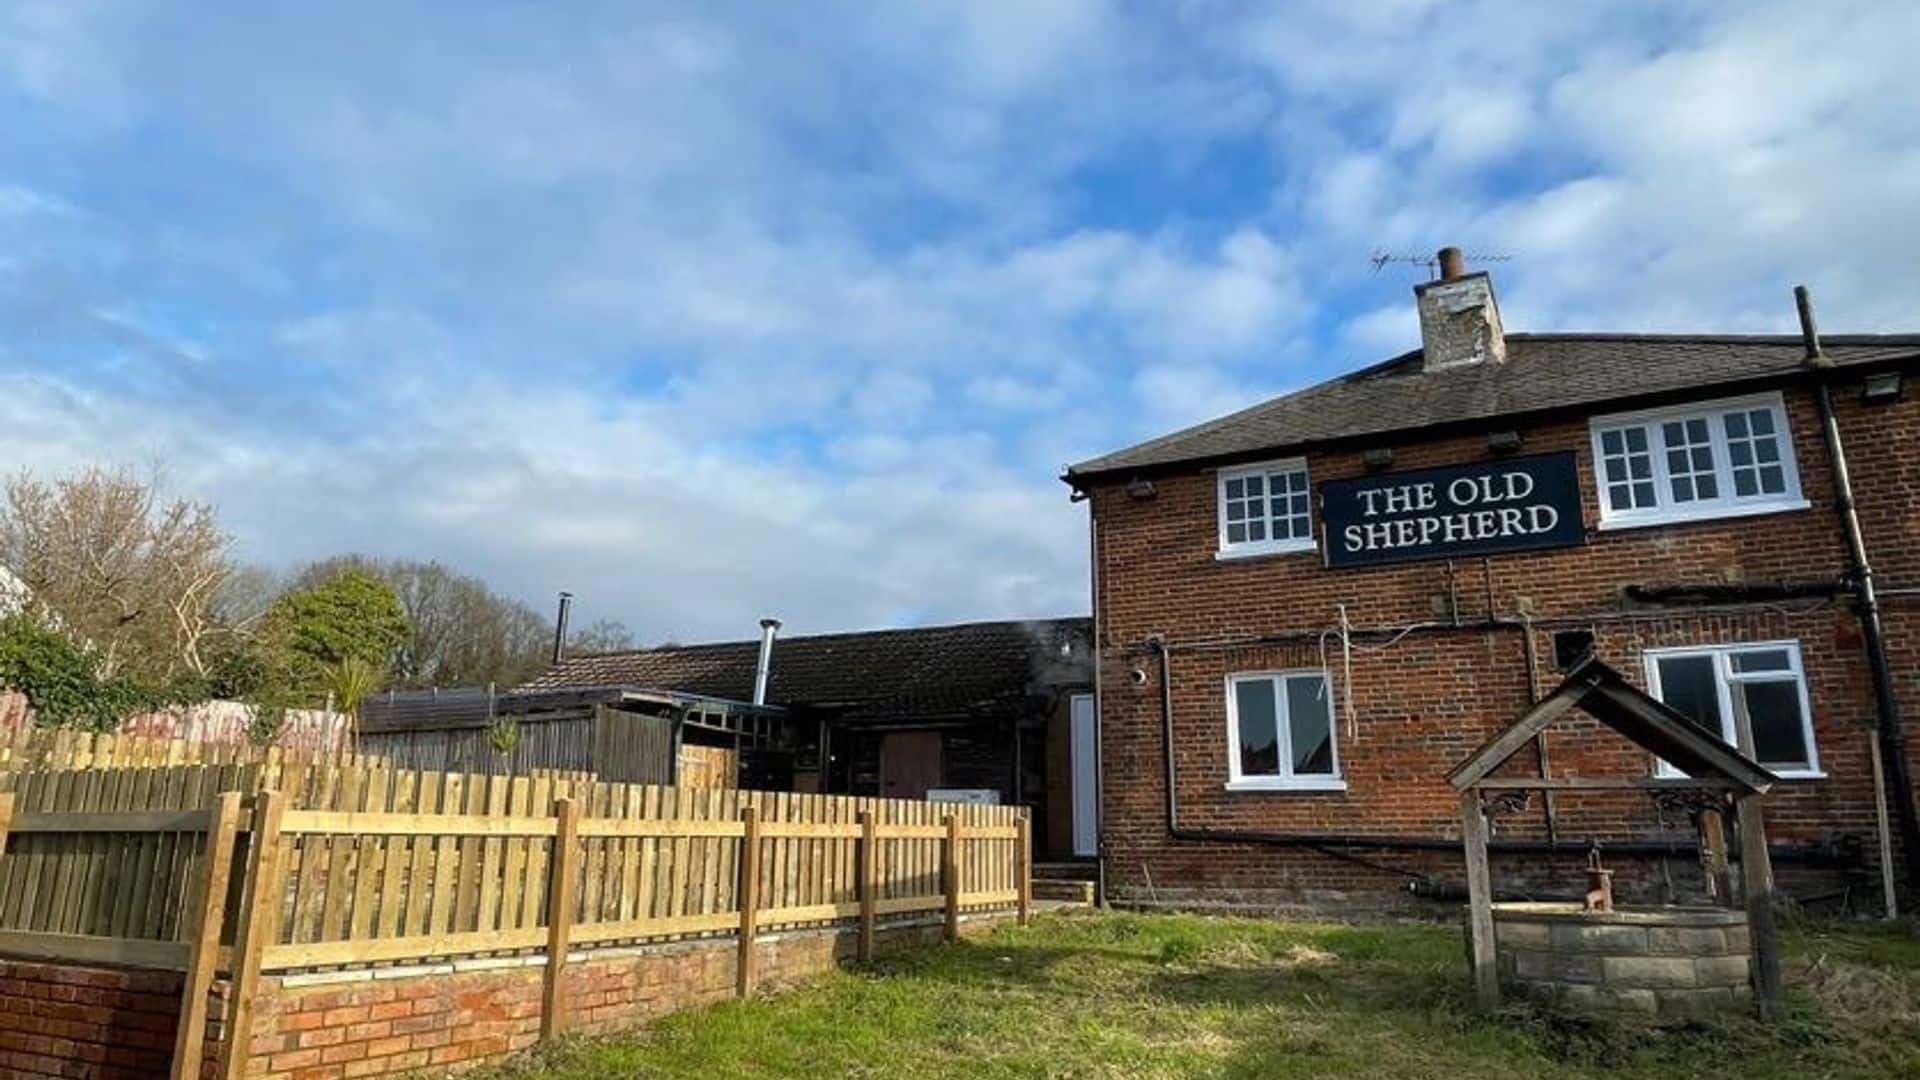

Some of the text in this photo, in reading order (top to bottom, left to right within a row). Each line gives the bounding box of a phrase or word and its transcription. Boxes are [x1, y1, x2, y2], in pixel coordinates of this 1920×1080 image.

[1357, 472, 1534, 516] THE OLD
[1344, 504, 1559, 552] SHEPHERD
